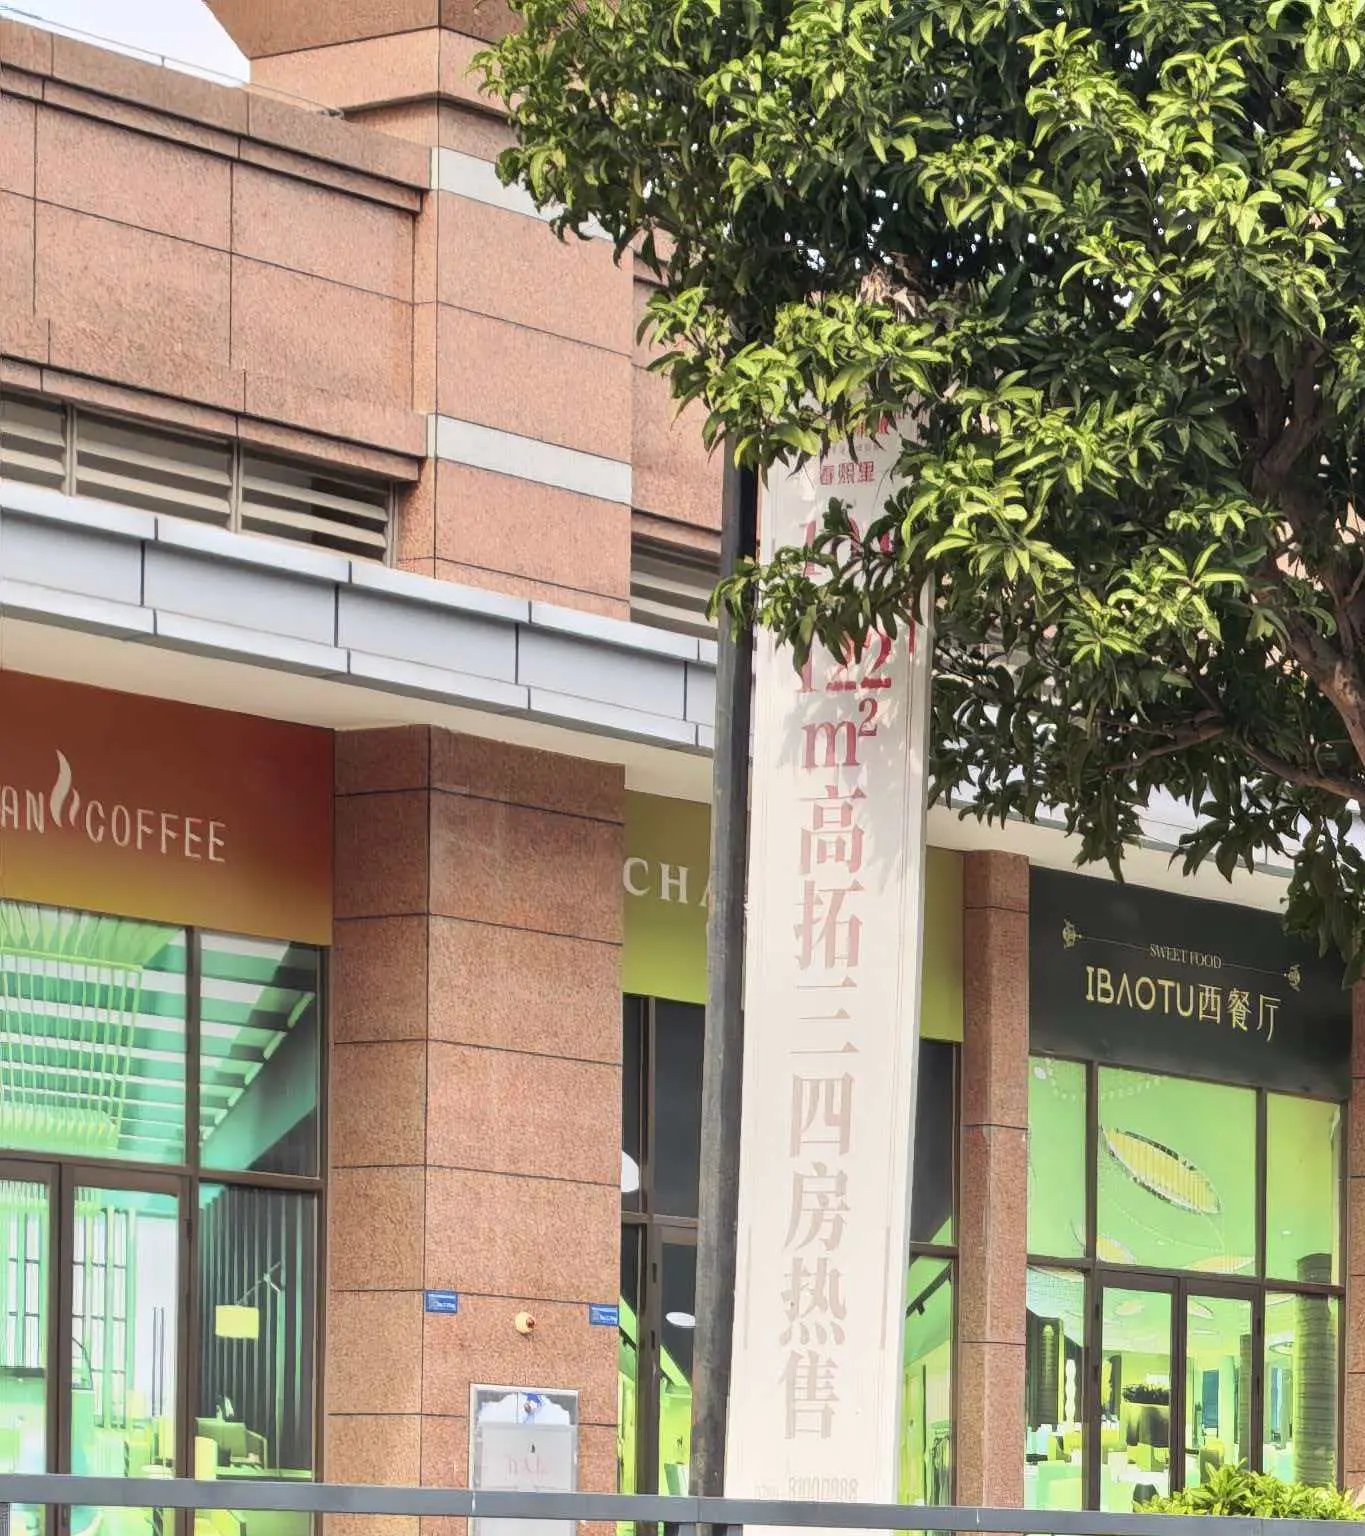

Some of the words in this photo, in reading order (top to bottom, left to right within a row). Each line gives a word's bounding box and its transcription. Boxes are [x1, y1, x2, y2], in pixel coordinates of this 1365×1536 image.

[85, 800, 227, 863] COFFEE
[1149, 943, 1188, 964] SWEET
[1189, 951, 1222, 970] FOOD
